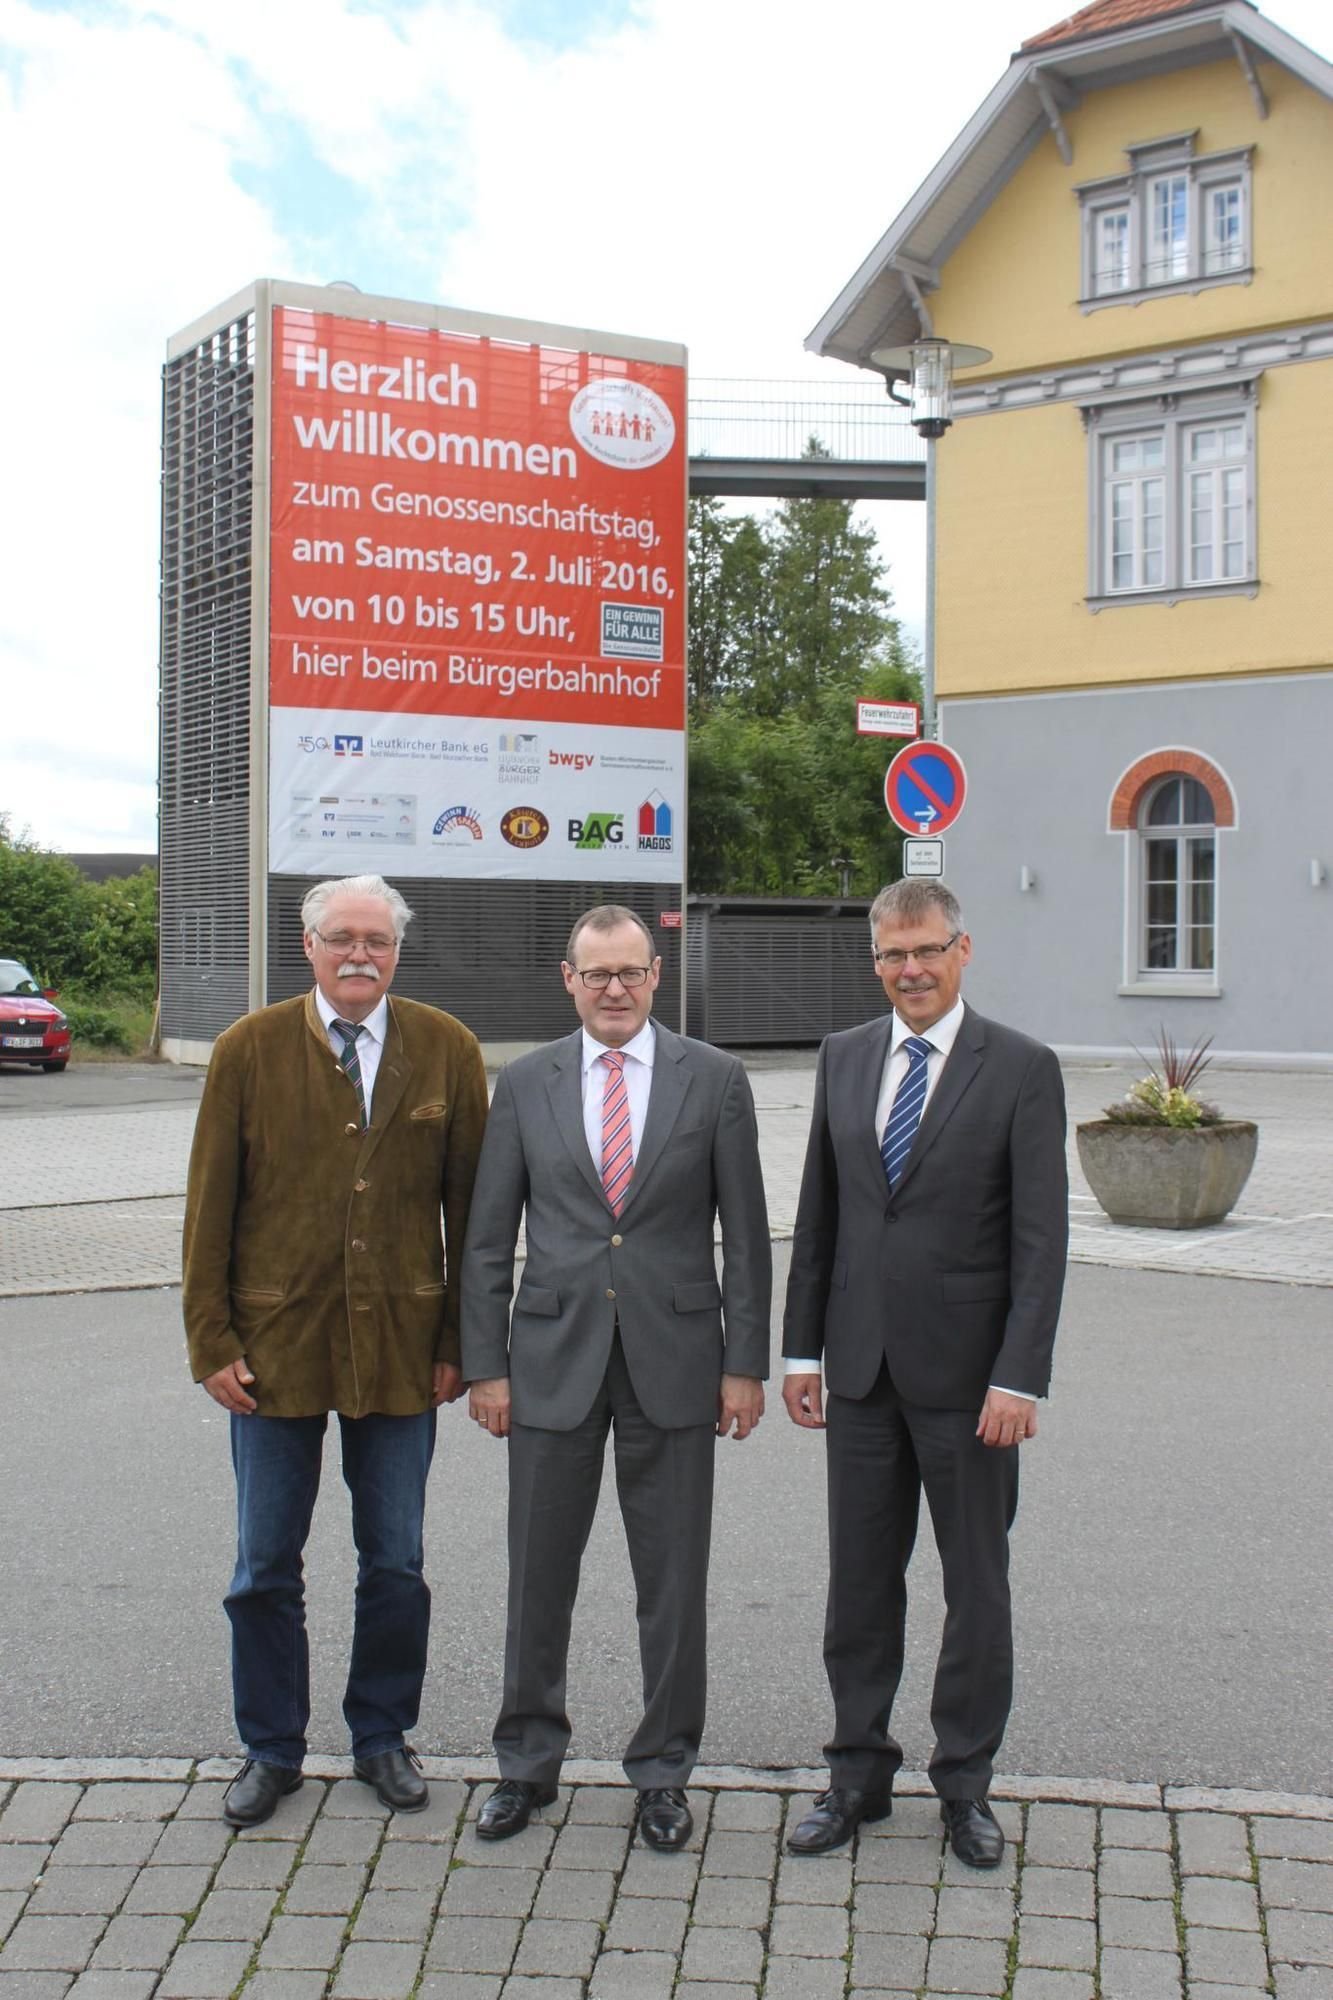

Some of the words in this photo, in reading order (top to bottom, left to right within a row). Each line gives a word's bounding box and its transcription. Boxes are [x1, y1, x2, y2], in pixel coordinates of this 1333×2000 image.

[295, 345, 477, 409] Herzlich
[293, 408, 577, 479] willkommen
[292, 481, 360, 510] zum
[372, 482, 661, 548] Genossenschaftstag,
[292, 539, 344, 565] am
[355, 537, 501, 585] Samstag,
[510, 552, 537, 582] 2.
[545, 555, 592, 587] Juli
[601, 561, 675, 600] 2016,
[292, 595, 355, 622] von
[368, 594, 405, 625] 10
[416, 596, 459, 629] bis
[470, 602, 505, 632] 15
[516, 605, 576, 642] Uhr,
[605, 609, 621, 620] EIN
[623, 611, 660, 625] GEWINN
[605, 620, 629, 638] FÜR
[630, 625, 660, 641] ALLE
[292, 643, 352, 677] hier
[363, 647, 437, 683] beim
[449, 655, 661, 697] Bürgerbahnhof
[861, 705, 914, 721] Feuerwehrzufahrt
[370, 737, 436, 751] Leutkircher
[441, 740, 469, 753] Bank
[473, 743, 489, 754] eG
[549, 749, 594, 771] bwgv
[568, 819, 623, 843] BAG
[638, 837, 671, 850] HAGOS
